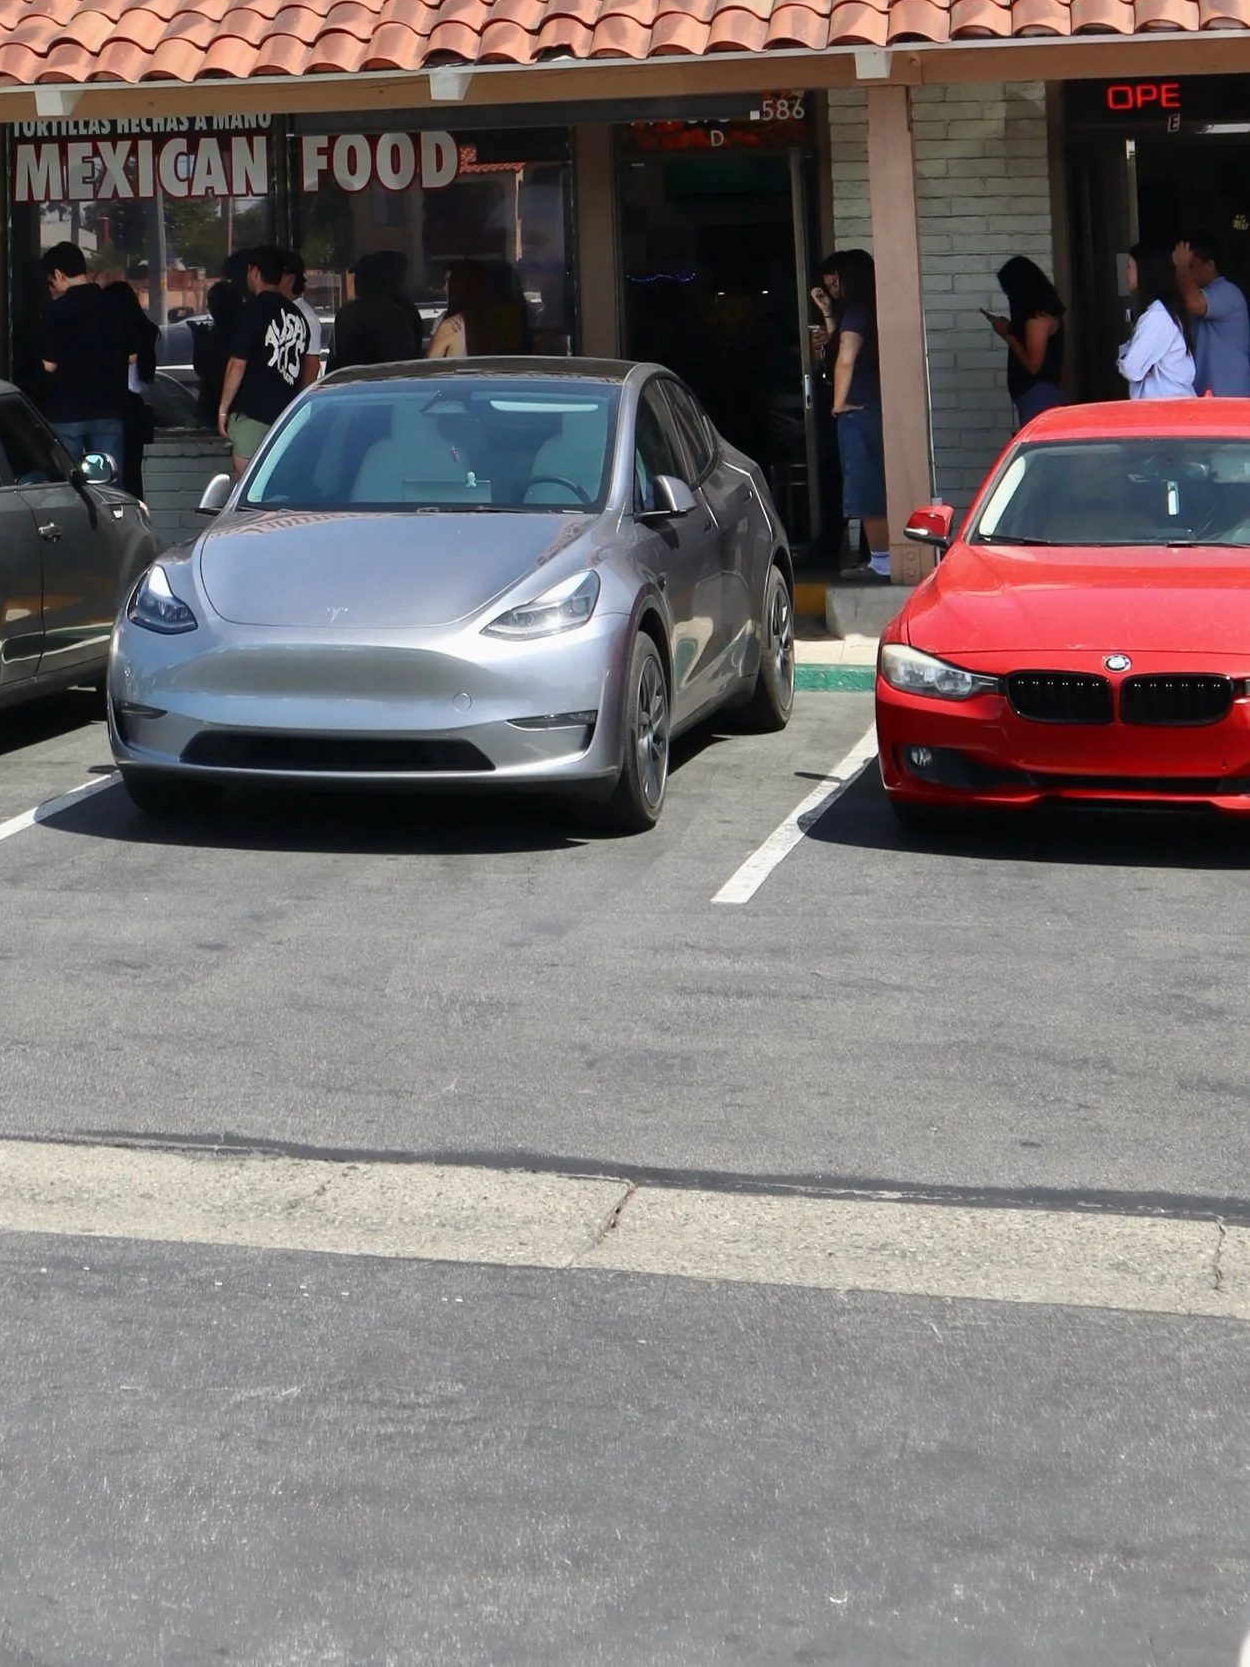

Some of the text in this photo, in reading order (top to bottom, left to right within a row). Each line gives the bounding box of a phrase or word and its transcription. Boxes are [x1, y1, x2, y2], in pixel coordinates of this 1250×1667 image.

[762, 99, 805, 121] 586
[710, 130, 725, 147] D
[14, 131, 458, 202] MEXICAN FOOD
